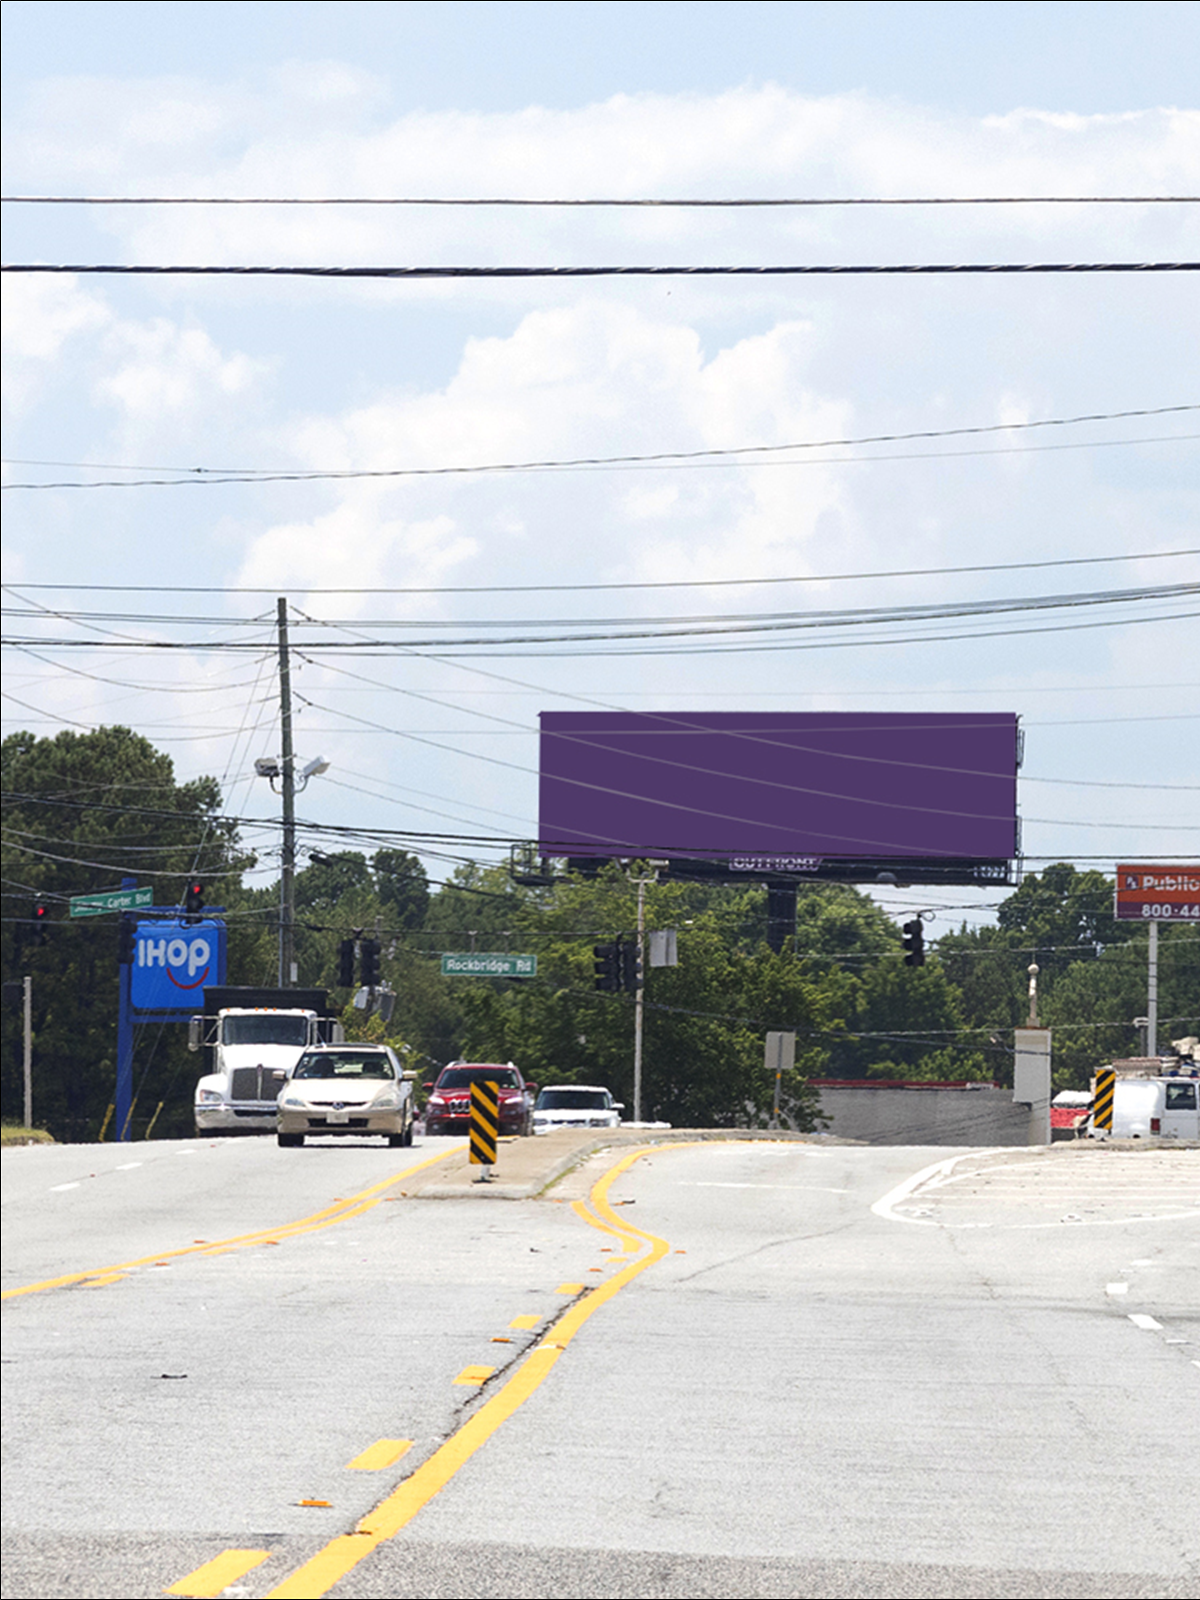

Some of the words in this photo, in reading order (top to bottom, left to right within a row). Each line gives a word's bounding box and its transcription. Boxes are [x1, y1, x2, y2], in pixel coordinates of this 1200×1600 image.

[1143, 876, 1200, 891] Public
[446, 959, 510, 973] Rockbridge
[516, 960, 532, 972] Rd
